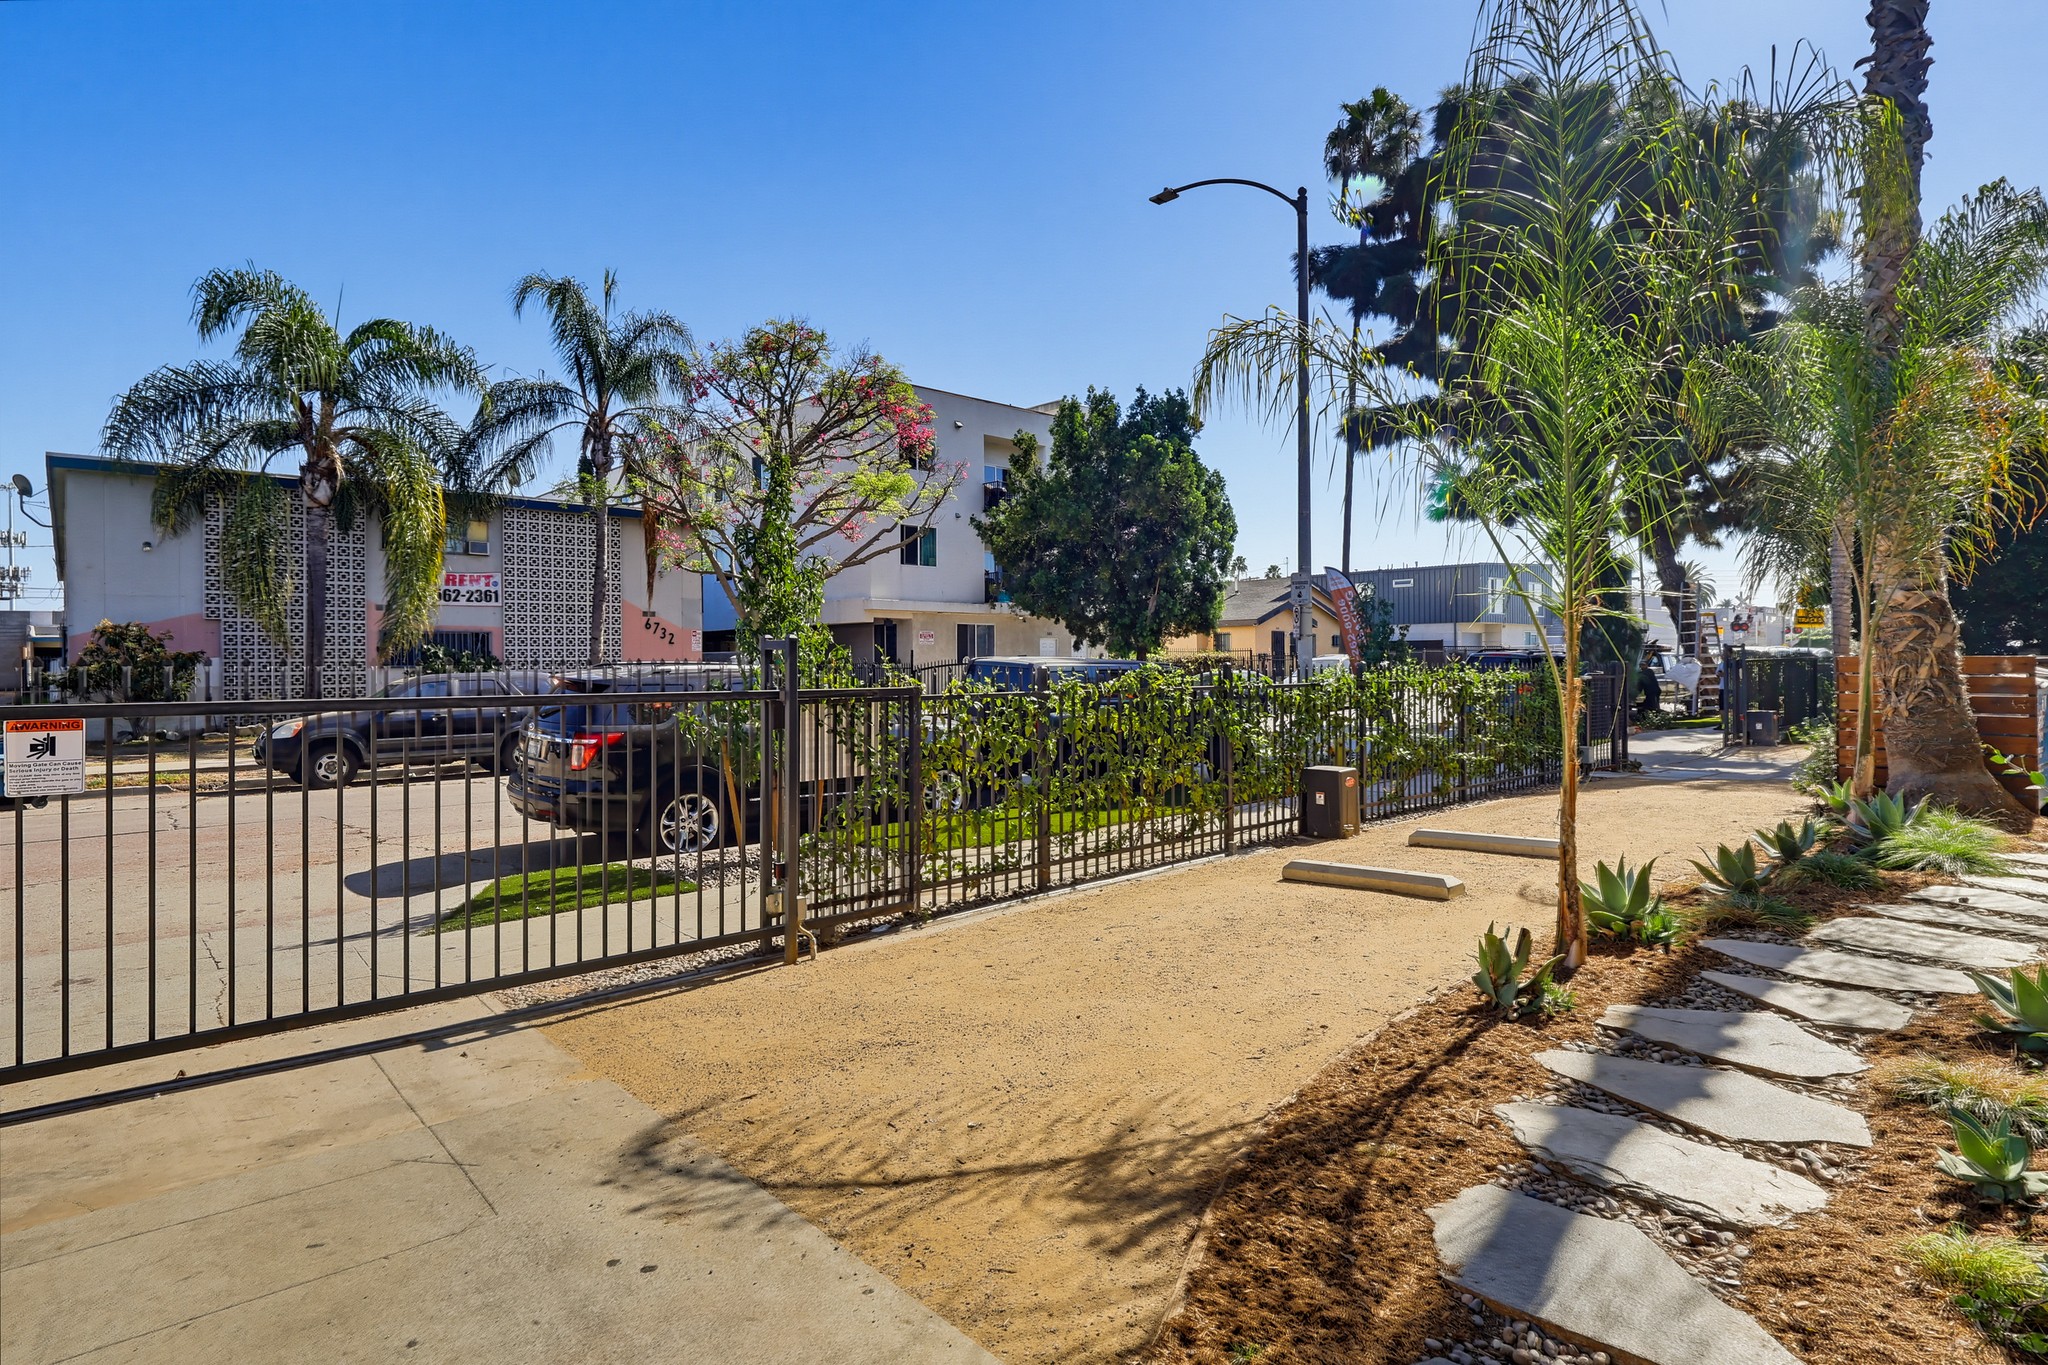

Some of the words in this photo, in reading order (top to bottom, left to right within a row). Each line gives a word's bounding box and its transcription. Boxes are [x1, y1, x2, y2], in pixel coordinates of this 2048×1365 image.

[444, 574, 494, 587] RENT
[644, 617, 675, 645] 6732
[19, 721, 81, 731] WARNING
